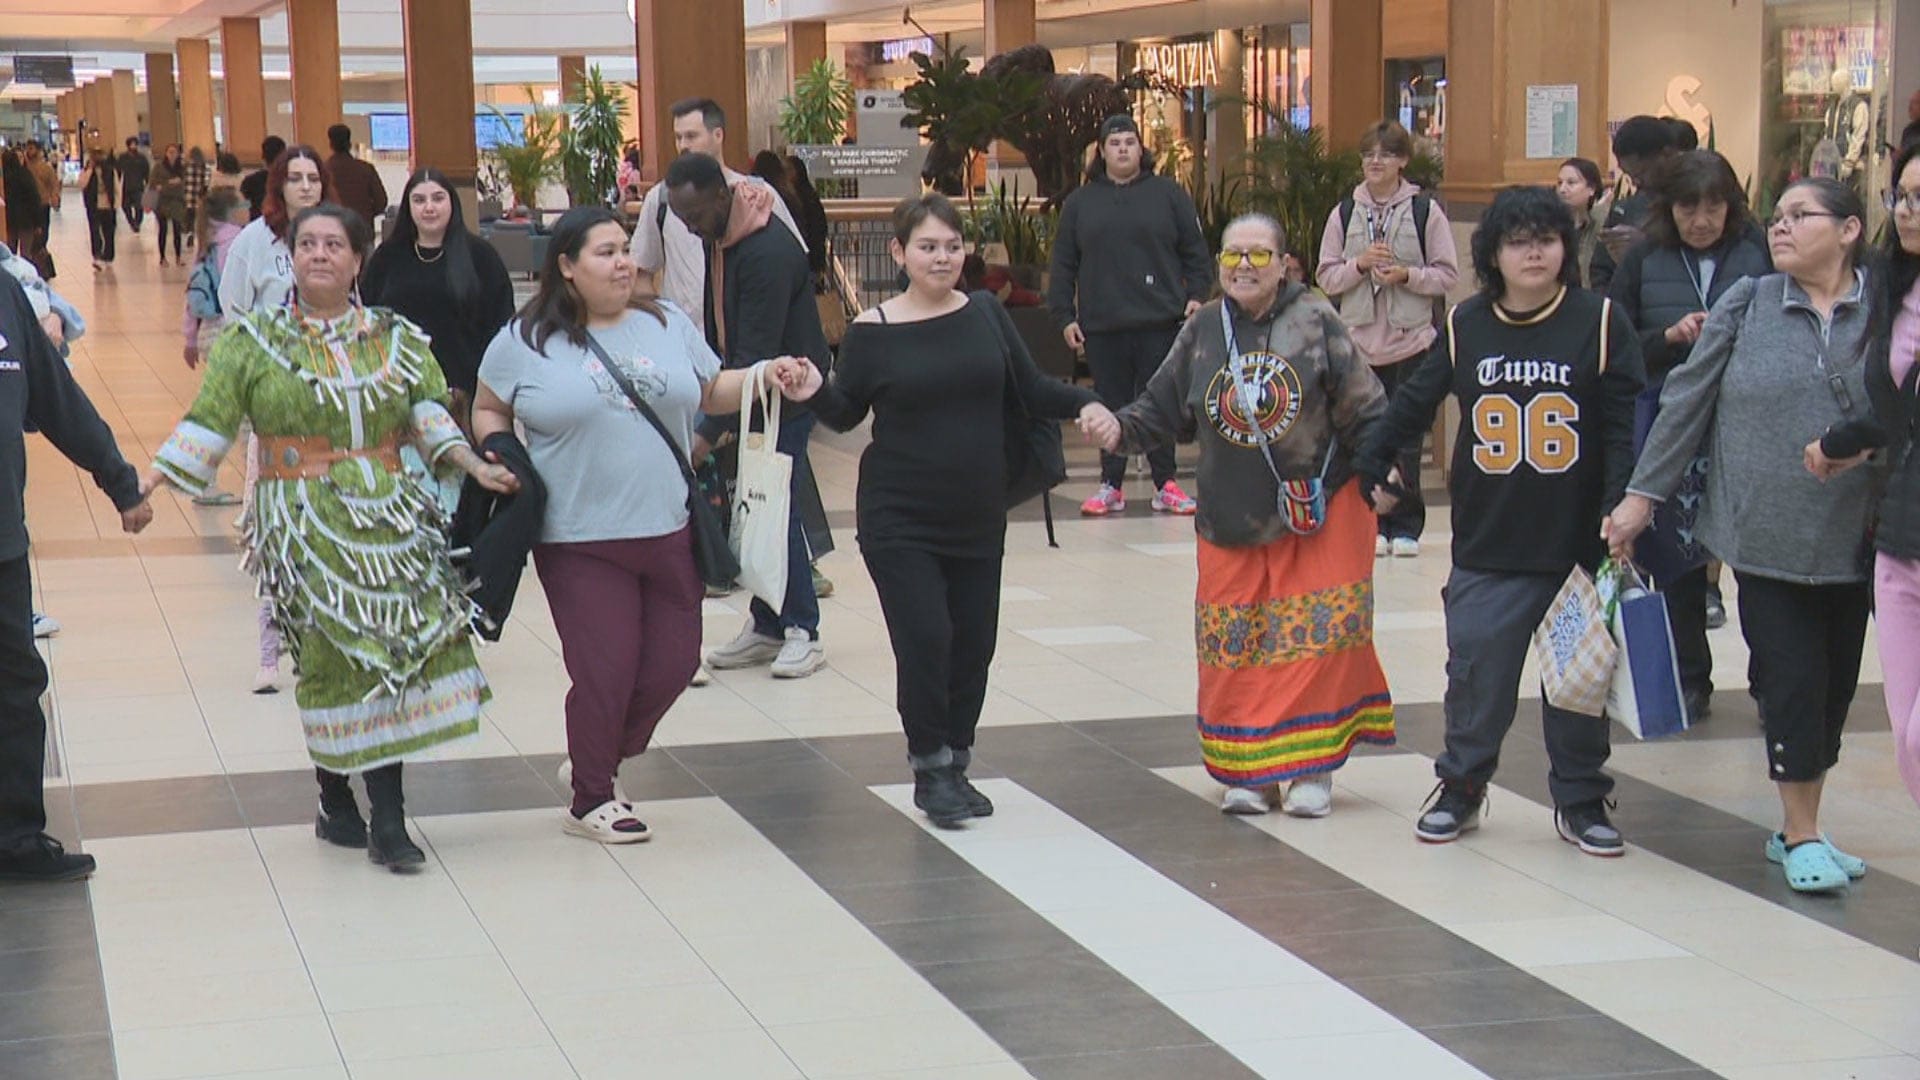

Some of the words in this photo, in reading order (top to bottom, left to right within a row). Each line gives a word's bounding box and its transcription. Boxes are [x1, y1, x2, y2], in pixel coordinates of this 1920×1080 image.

[1145, 41, 1217, 87] ARITZIA
[1476, 355, 1571, 387] Tupac
[1472, 391, 1579, 474] 96
